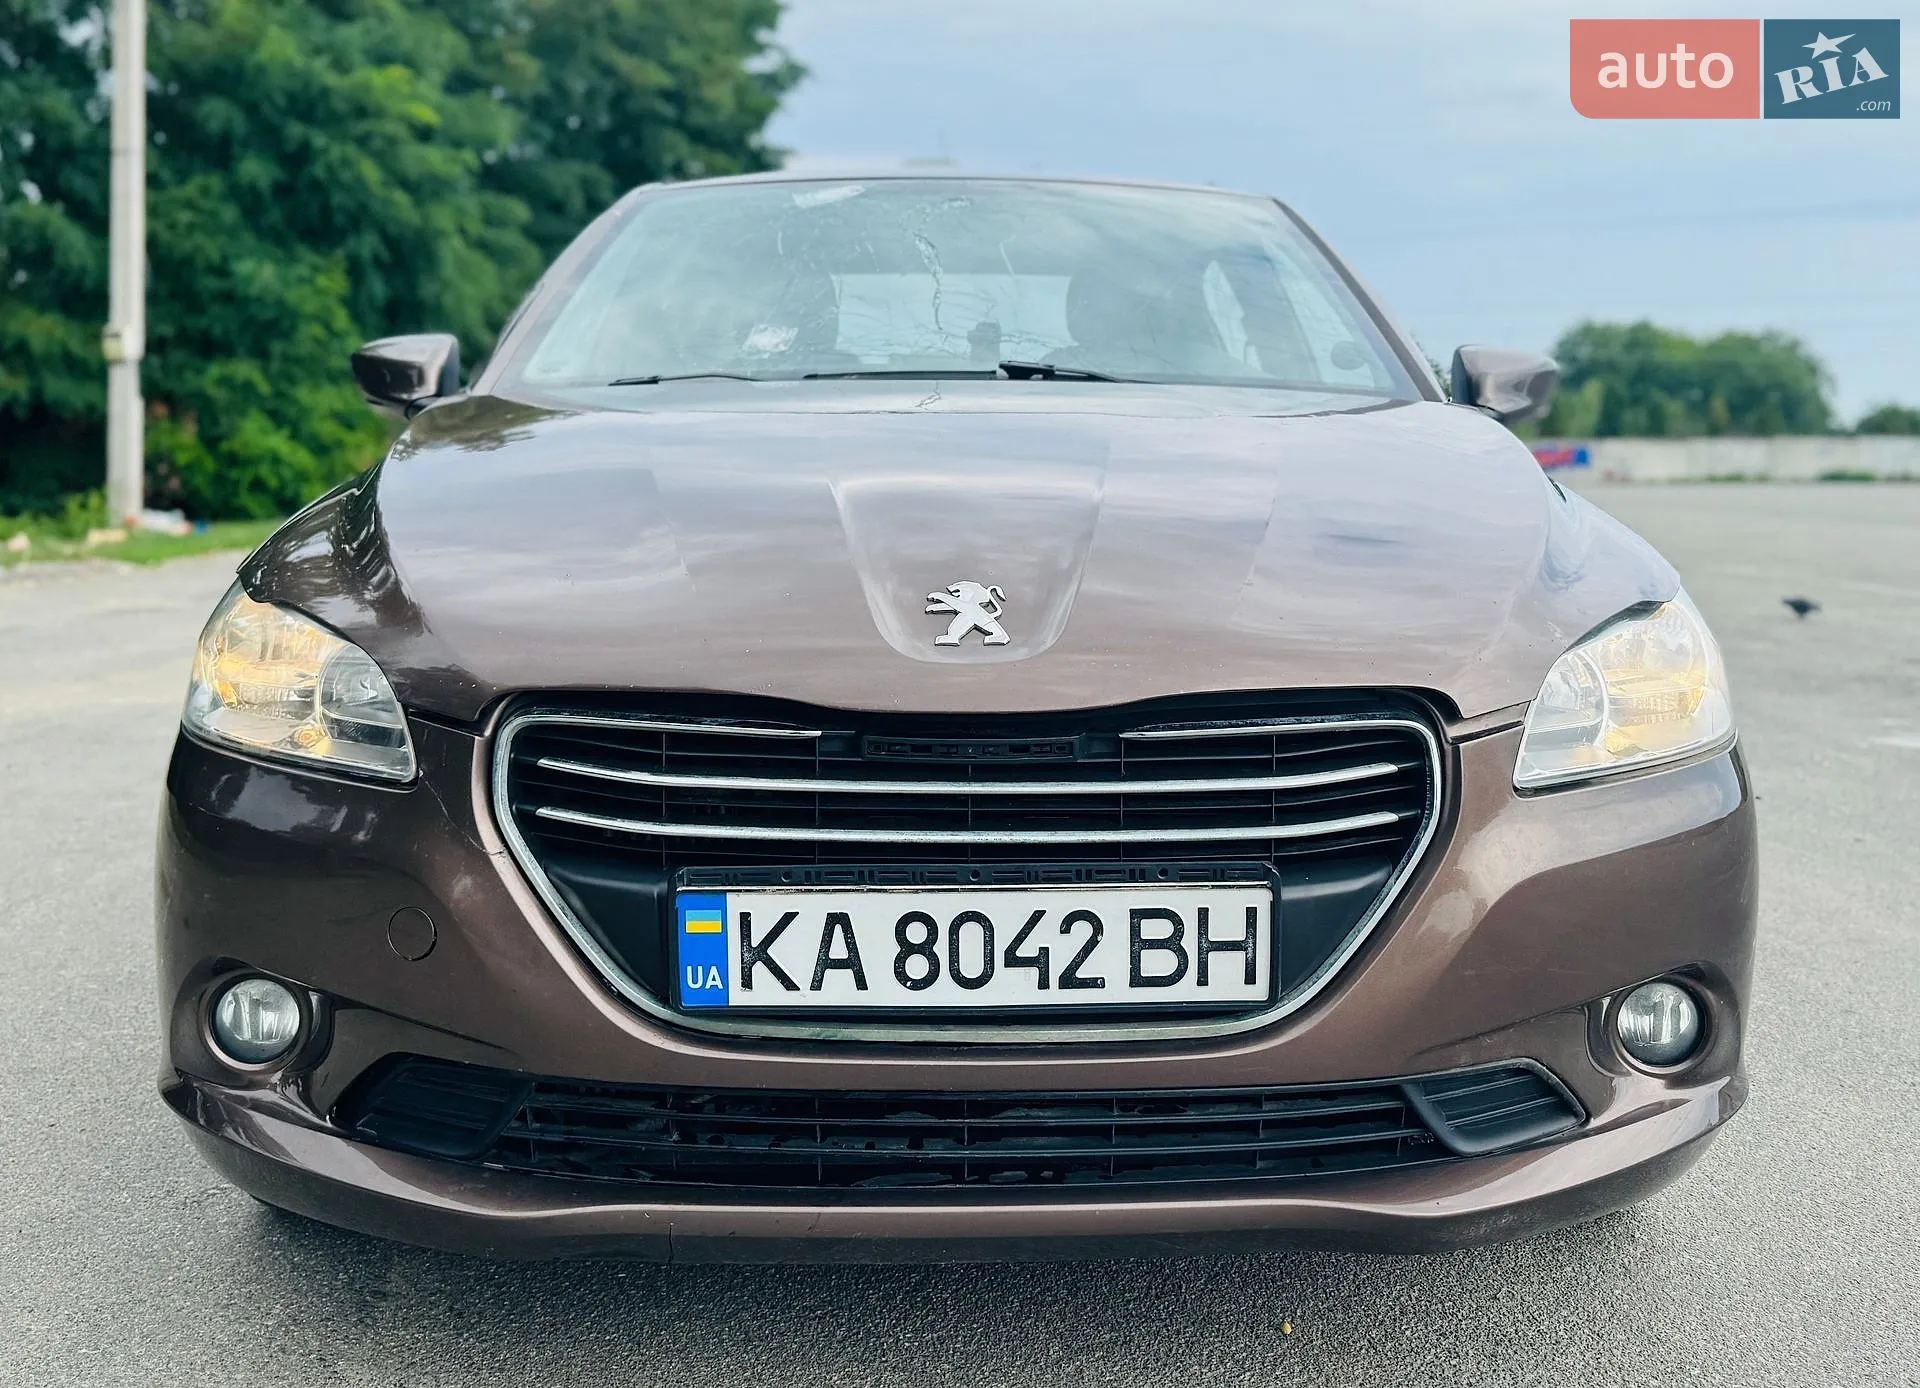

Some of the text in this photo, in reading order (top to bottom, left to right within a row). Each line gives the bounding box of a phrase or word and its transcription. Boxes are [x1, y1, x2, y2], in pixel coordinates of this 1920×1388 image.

[738, 906, 1258, 991] KA 8042 BH
[686, 965, 724, 990] UA
